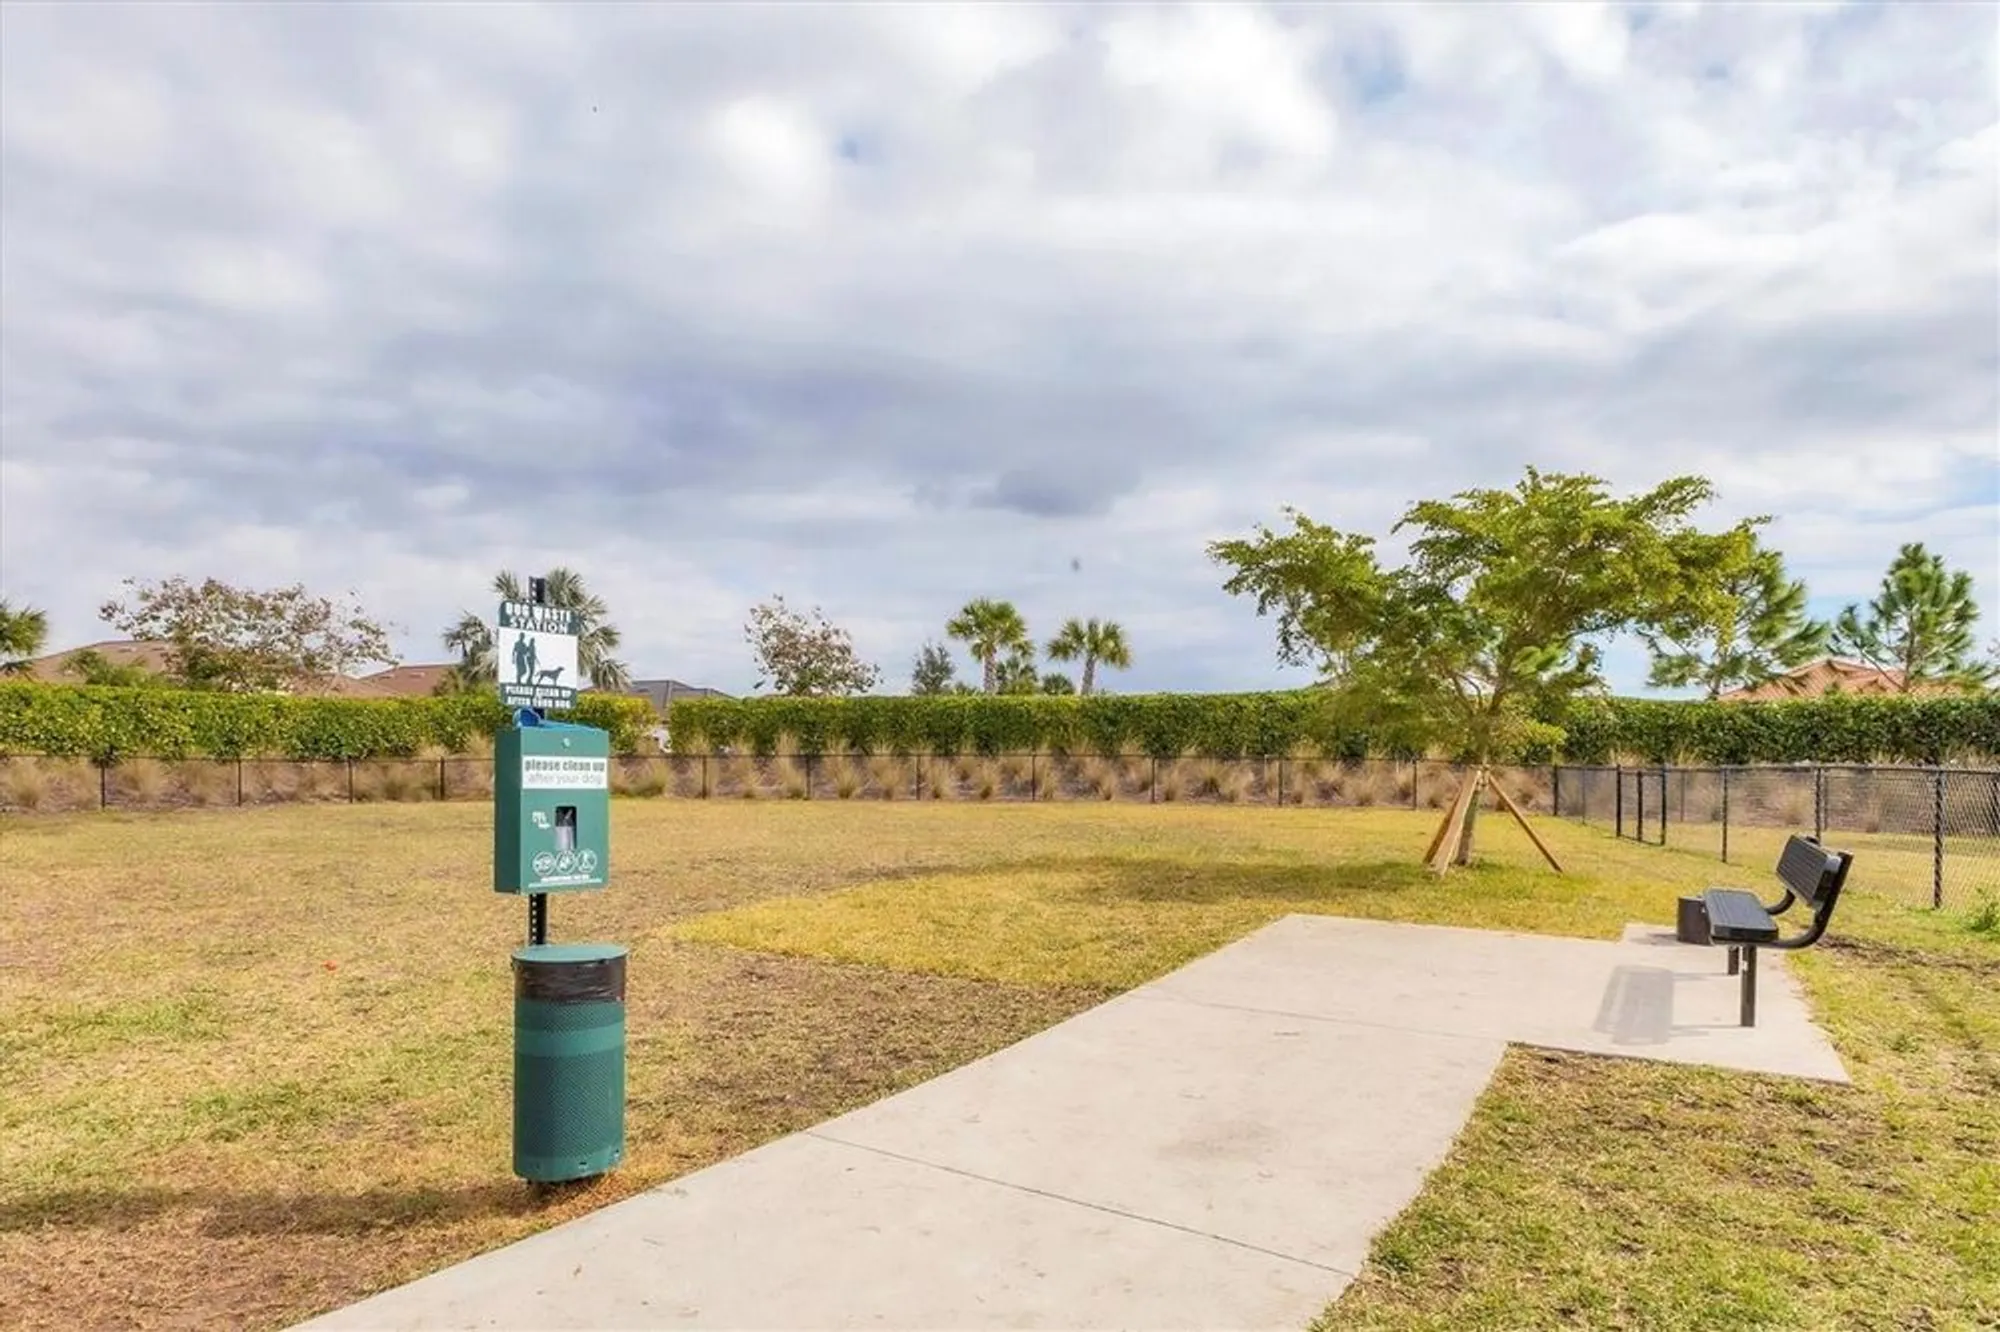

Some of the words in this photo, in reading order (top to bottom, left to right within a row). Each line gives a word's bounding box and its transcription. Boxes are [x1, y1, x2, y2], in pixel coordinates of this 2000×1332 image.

[532, 605, 572, 623] WASTE
[510, 618, 568, 634] STATION
[524, 758, 561, 771] please
[562, 760, 591, 771] clean
[593, 762, 605, 772] up
[527, 772, 554, 784] after
[556, 774, 580, 786] your
[582, 773, 603, 787] dog
